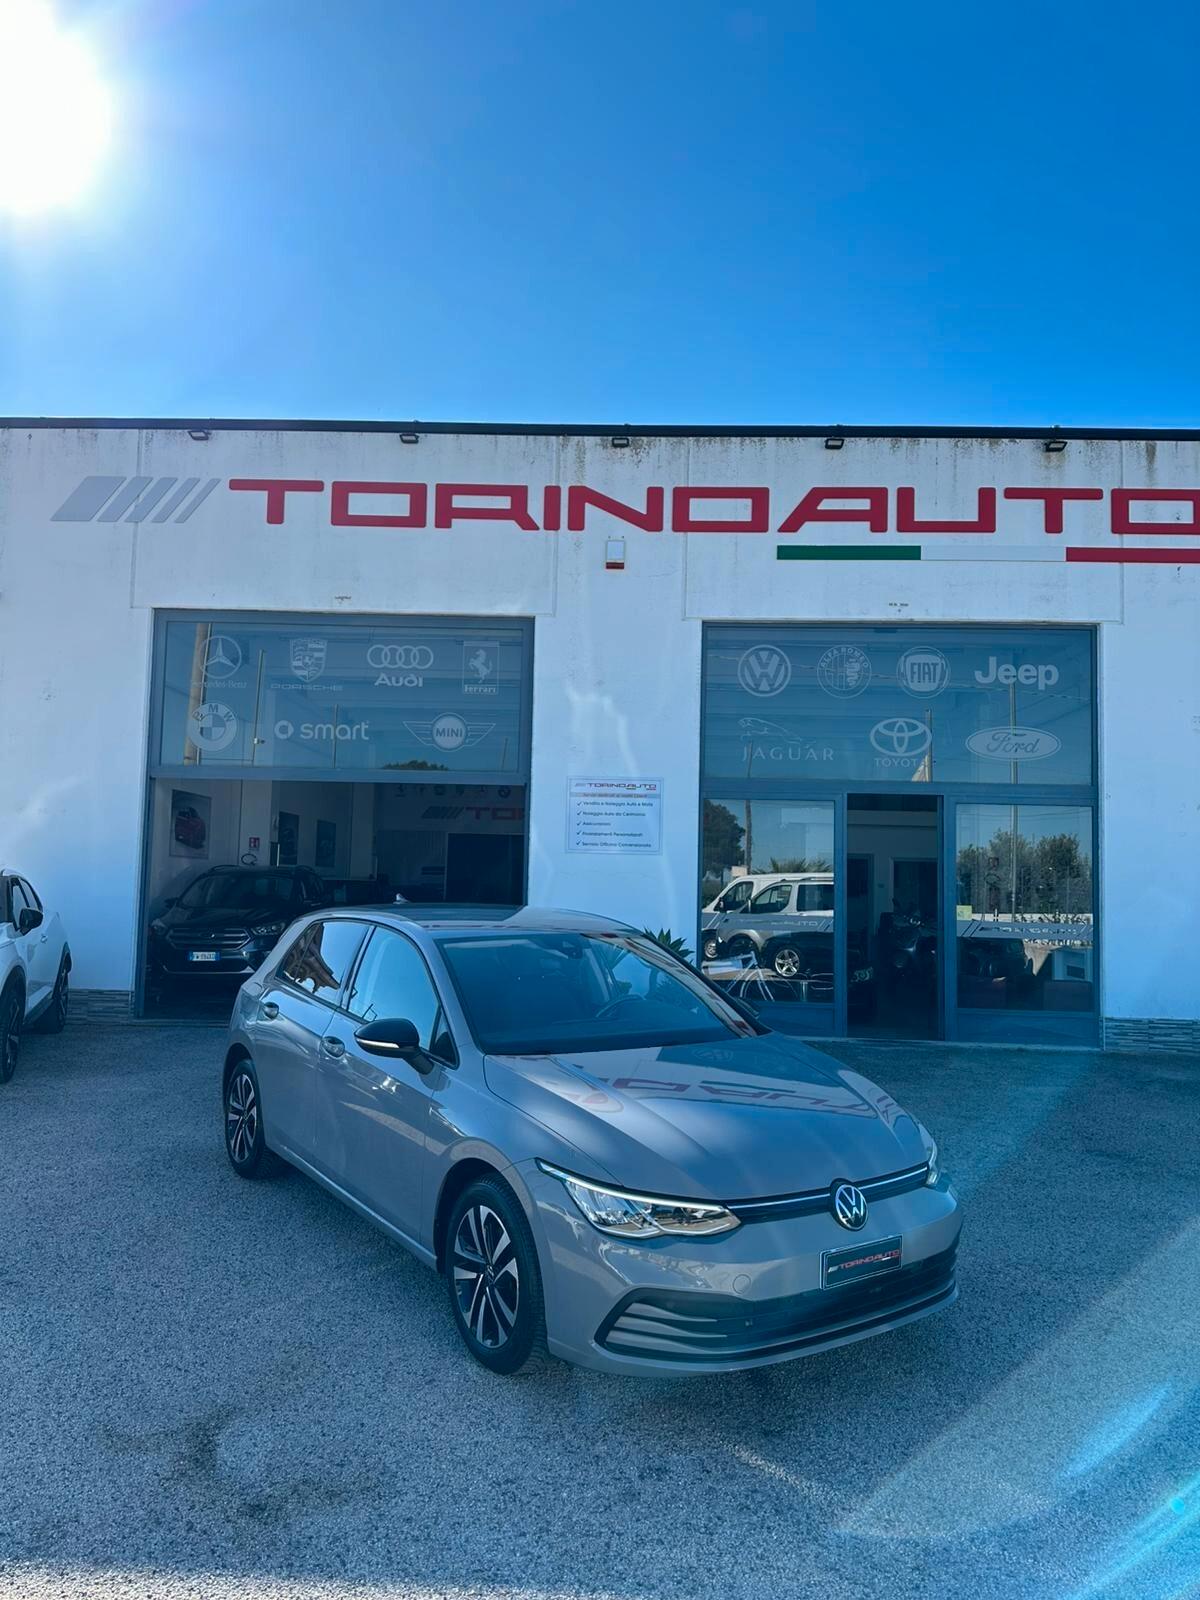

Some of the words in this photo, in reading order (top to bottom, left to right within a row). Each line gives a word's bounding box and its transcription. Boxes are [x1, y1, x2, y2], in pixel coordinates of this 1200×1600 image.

[229, 479, 1200, 534] TORINOAUTO
[374, 672, 424, 687] Audi
[911, 662, 939, 683] FIAT
[974, 656, 1060, 690] Jeep
[464, 685, 496, 693] Ferrari
[193, 704, 234, 722] BMW
[300, 720, 369, 740] smart
[436, 728, 463, 737] MINI
[986, 731, 1041, 754] Ford
[742, 746, 834, 761] JAGUAR
[874, 758, 924, 768] TOYOT
[840, 1249, 900, 1270] TORINOAUTO
